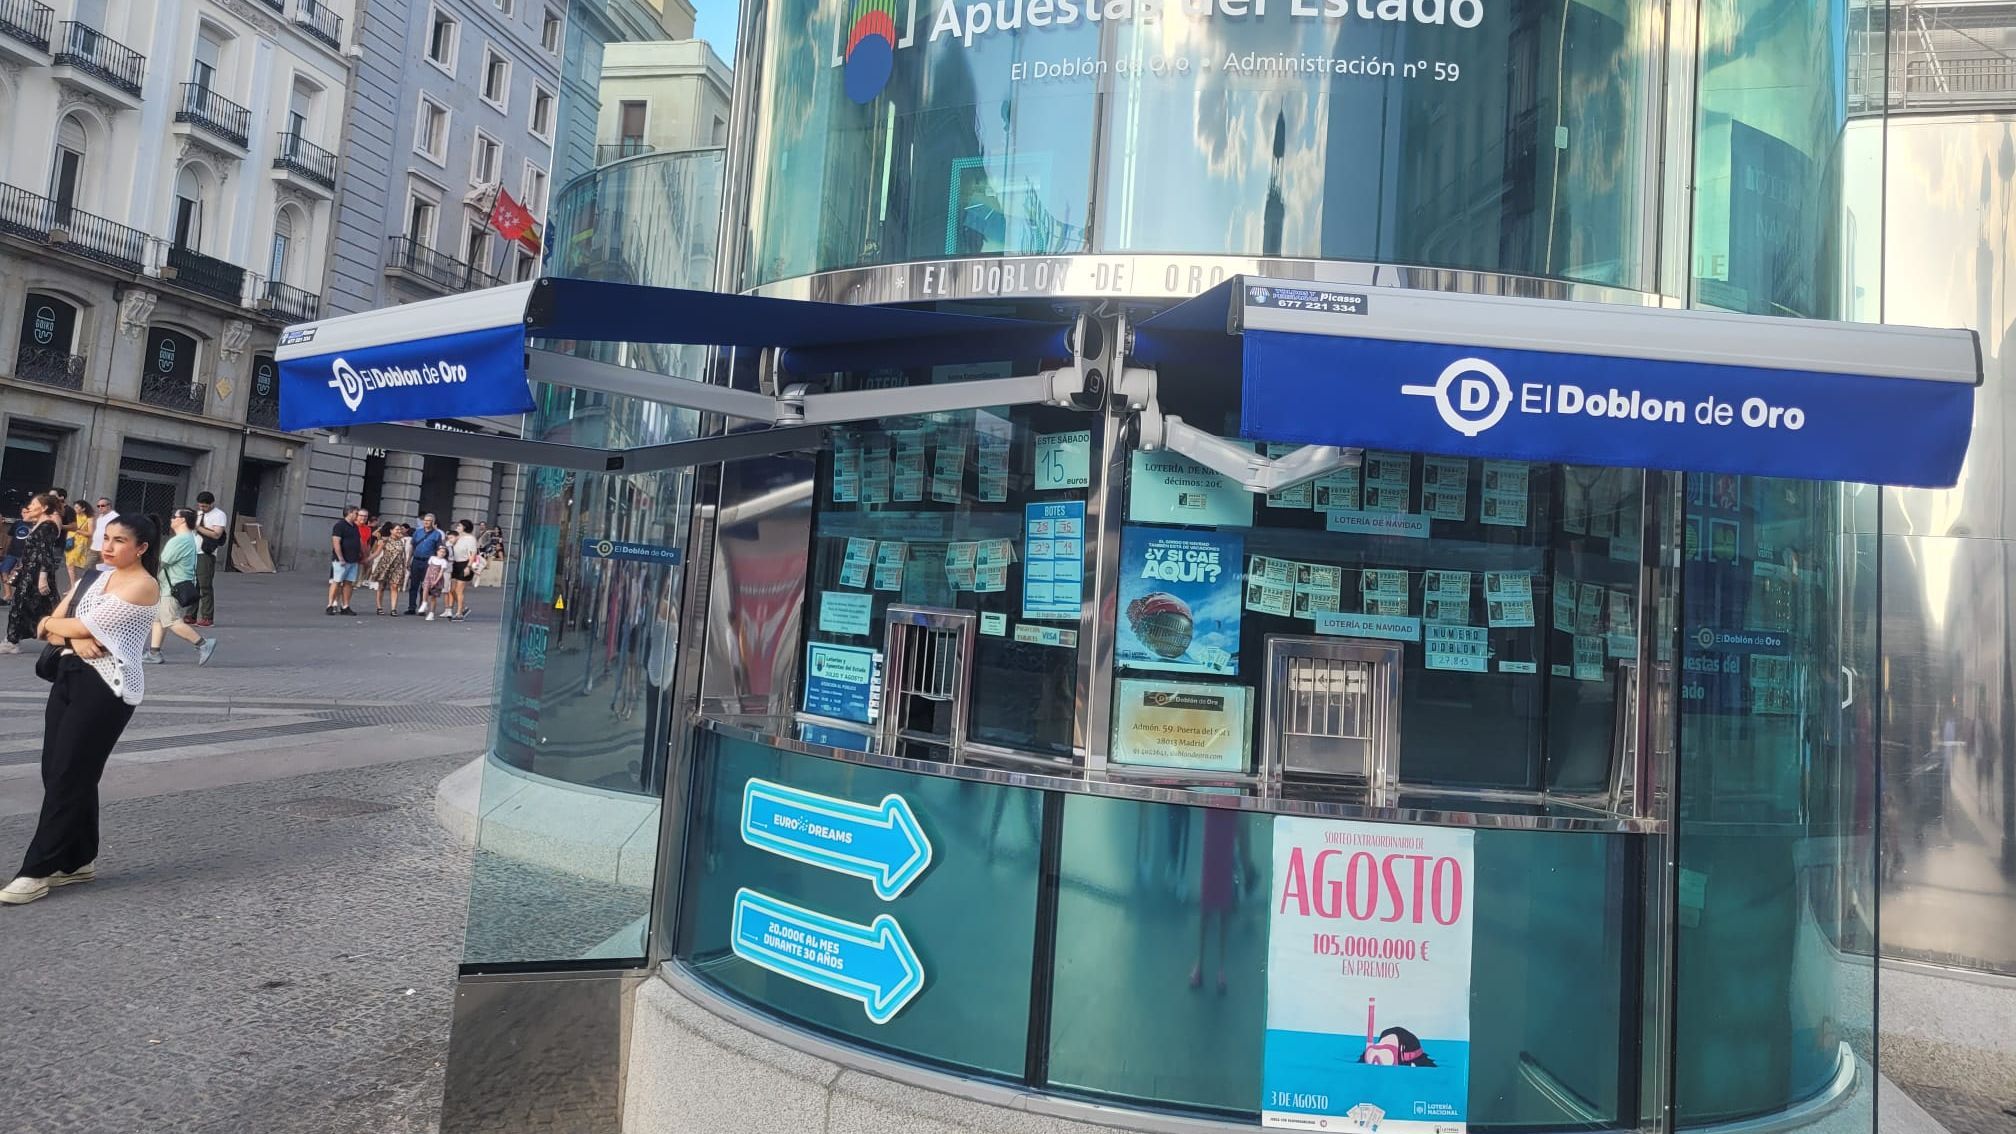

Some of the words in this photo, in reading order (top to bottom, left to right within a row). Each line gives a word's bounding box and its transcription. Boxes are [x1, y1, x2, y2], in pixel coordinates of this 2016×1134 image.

[1011, 61, 1027, 81] El
[1034, 57, 1107, 79] Doblón
[1223, 52, 1395, 77] Administración
[1435, 62, 1460, 82] 59
[922, 266, 947, 295] EL
[971, 258, 1067, 294] DOBLÓN
[1096, 262, 1123, 292] DE
[1278, 299, 1302, 308] 677
[1305, 301, 1328, 310] 221
[1332, 303, 1356, 312] 334
[1320, 292, 1361, 304] Picasso
[363, 370, 377, 391] El
[376, 367, 423, 388] Doblon
[422, 364, 439, 383] de
[439, 361, 467, 383] Oro
[1460, 379, 1490, 412] D
[1521, 383, 1552, 413] El
[1558, 384, 1686, 423] Doblon
[1695, 395, 1733, 426] de
[1742, 397, 1805, 431] Oro
[1038, 436, 1056, 445] ESTE
[1057, 434, 1090, 444] SÁBADO
[1041, 449, 1065, 483] 15
[1145, 463, 1183, 474] LOTERÍA
[1188, 467, 1201, 475] DE
[1165, 477, 1203, 487] décimos:
[1044, 505, 1066, 517] BOTES
[1334, 515, 1370, 526] LOTERÍA
[1372, 518, 1385, 527] DE
[1386, 519, 1423, 530] NAVIDAD
[622, 546, 650, 556] Doblón
[660, 550, 675, 558] Oro
[1144, 548, 1165, 560] ¿Y
[1167, 550, 1183, 562] SI
[1185, 551, 1219, 564] CAE
[1140, 560, 1222, 583] AQUÍ?
[1323, 618, 1360, 629] LOTERÍA
[1362, 622, 1374, 630] DE
[1375, 622, 1413, 633] NAVIDAD
[1042, 631, 1057, 641] VISA
[1724, 633, 1753, 645] Doblón
[1754, 636, 1765, 645] de
[1765, 636, 1781, 647] Oro
[1723, 655, 1740, 674] del
[1178, 739, 1205, 748] Madrid
[773, 813, 798, 831] EURO
[807, 825, 853, 845] DREAMS
[1324, 831, 1353, 846] SORTEO
[1353, 834, 1414, 849] EXTRAORDINARIO
[1415, 838, 1425, 850] DE
[1279, 847, 1463, 926] AGOSTO
[768, 921, 805, 944] 20.000€
[806, 935, 819, 949] AL
[819, 939, 840, 955] MES
[1312, 933, 1416, 961] 105.000.000
[1420, 940, 1431, 962] €
[763, 933, 802, 957] DURANTE
[804, 948, 816, 962] 30
[816, 951, 844, 970] AÑOS
[1342, 958, 1355, 976] EN
[1356, 960, 1401, 979] PREMIOS
[1271, 1091, 1277, 1107] 3
[1278, 1092, 1291, 1108] DE
[1292, 1094, 1329, 1110] AGOSTO
[1427, 1102, 1453, 1110] LOTERÍA
